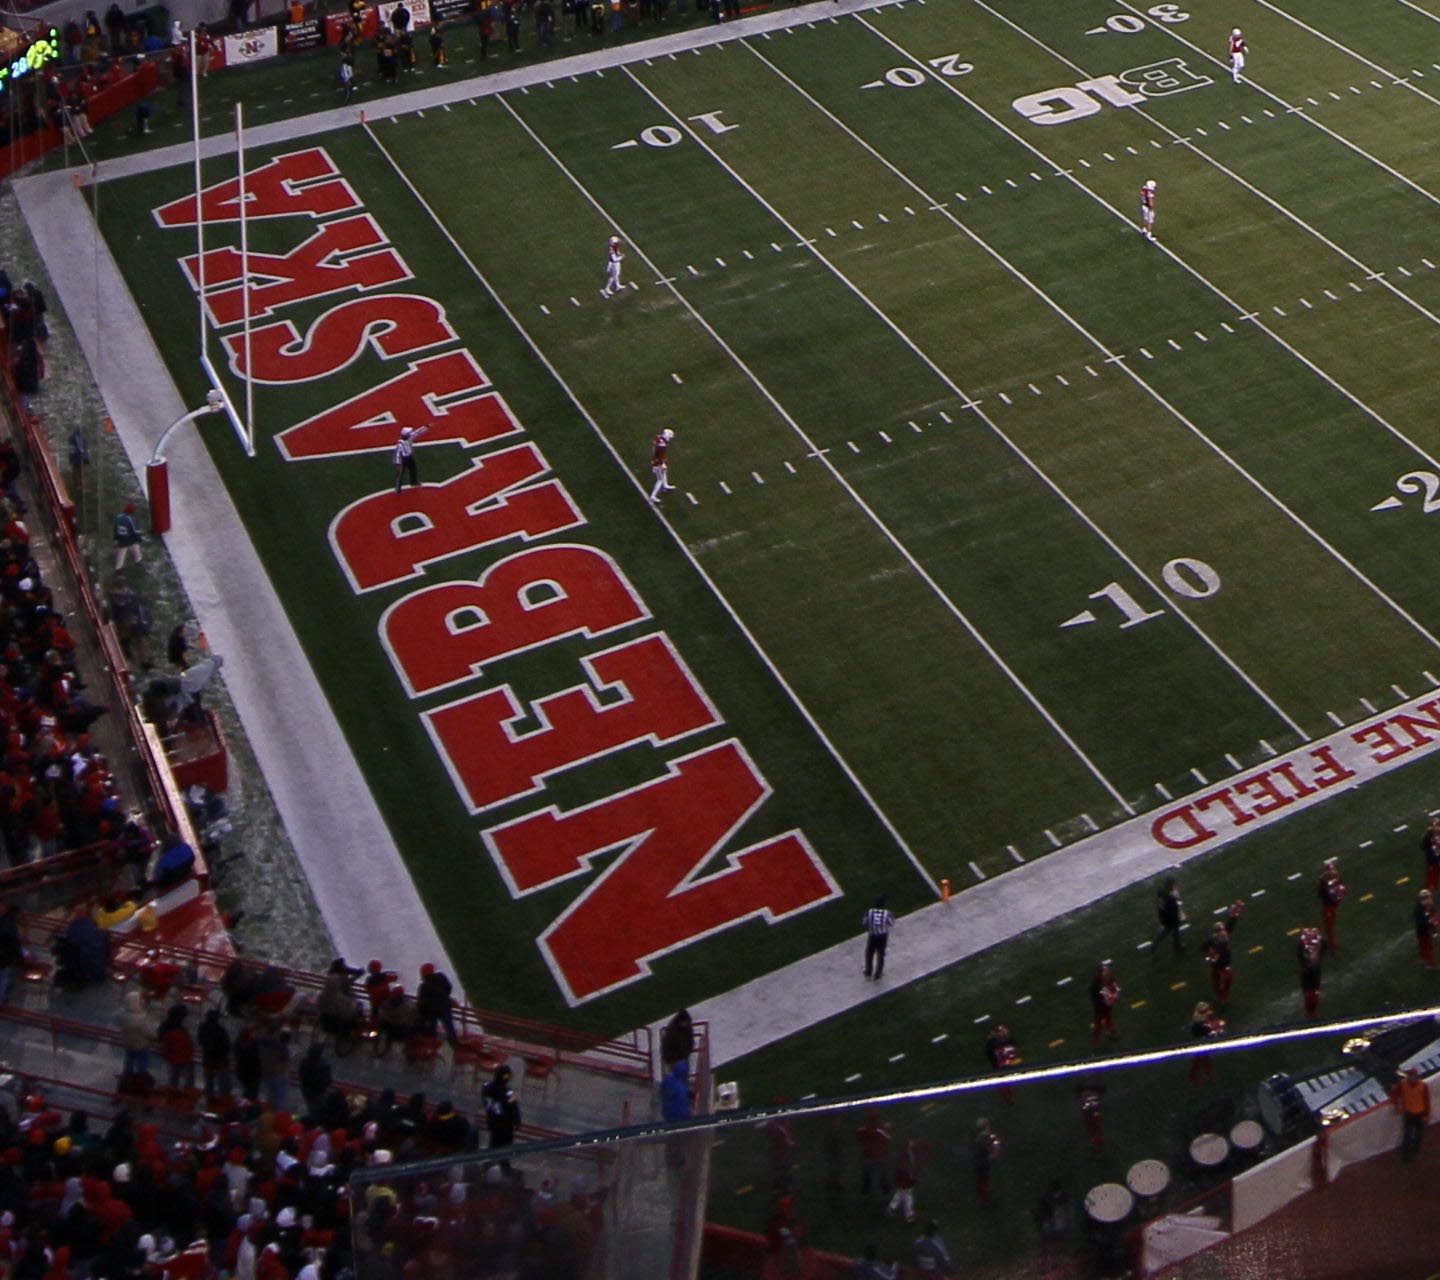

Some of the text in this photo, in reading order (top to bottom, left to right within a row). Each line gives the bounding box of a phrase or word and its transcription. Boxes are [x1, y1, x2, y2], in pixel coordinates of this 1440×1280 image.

[1103, 2, 1192, 36] 30
[885, 53, 975, 91] 20
[638, 109, 742, 150] 10
[150, 146, 845, 1008] NEBRASKA
[1087, 556, 1222, 632] 10
[1150, 734, 1358, 850] FIELD
